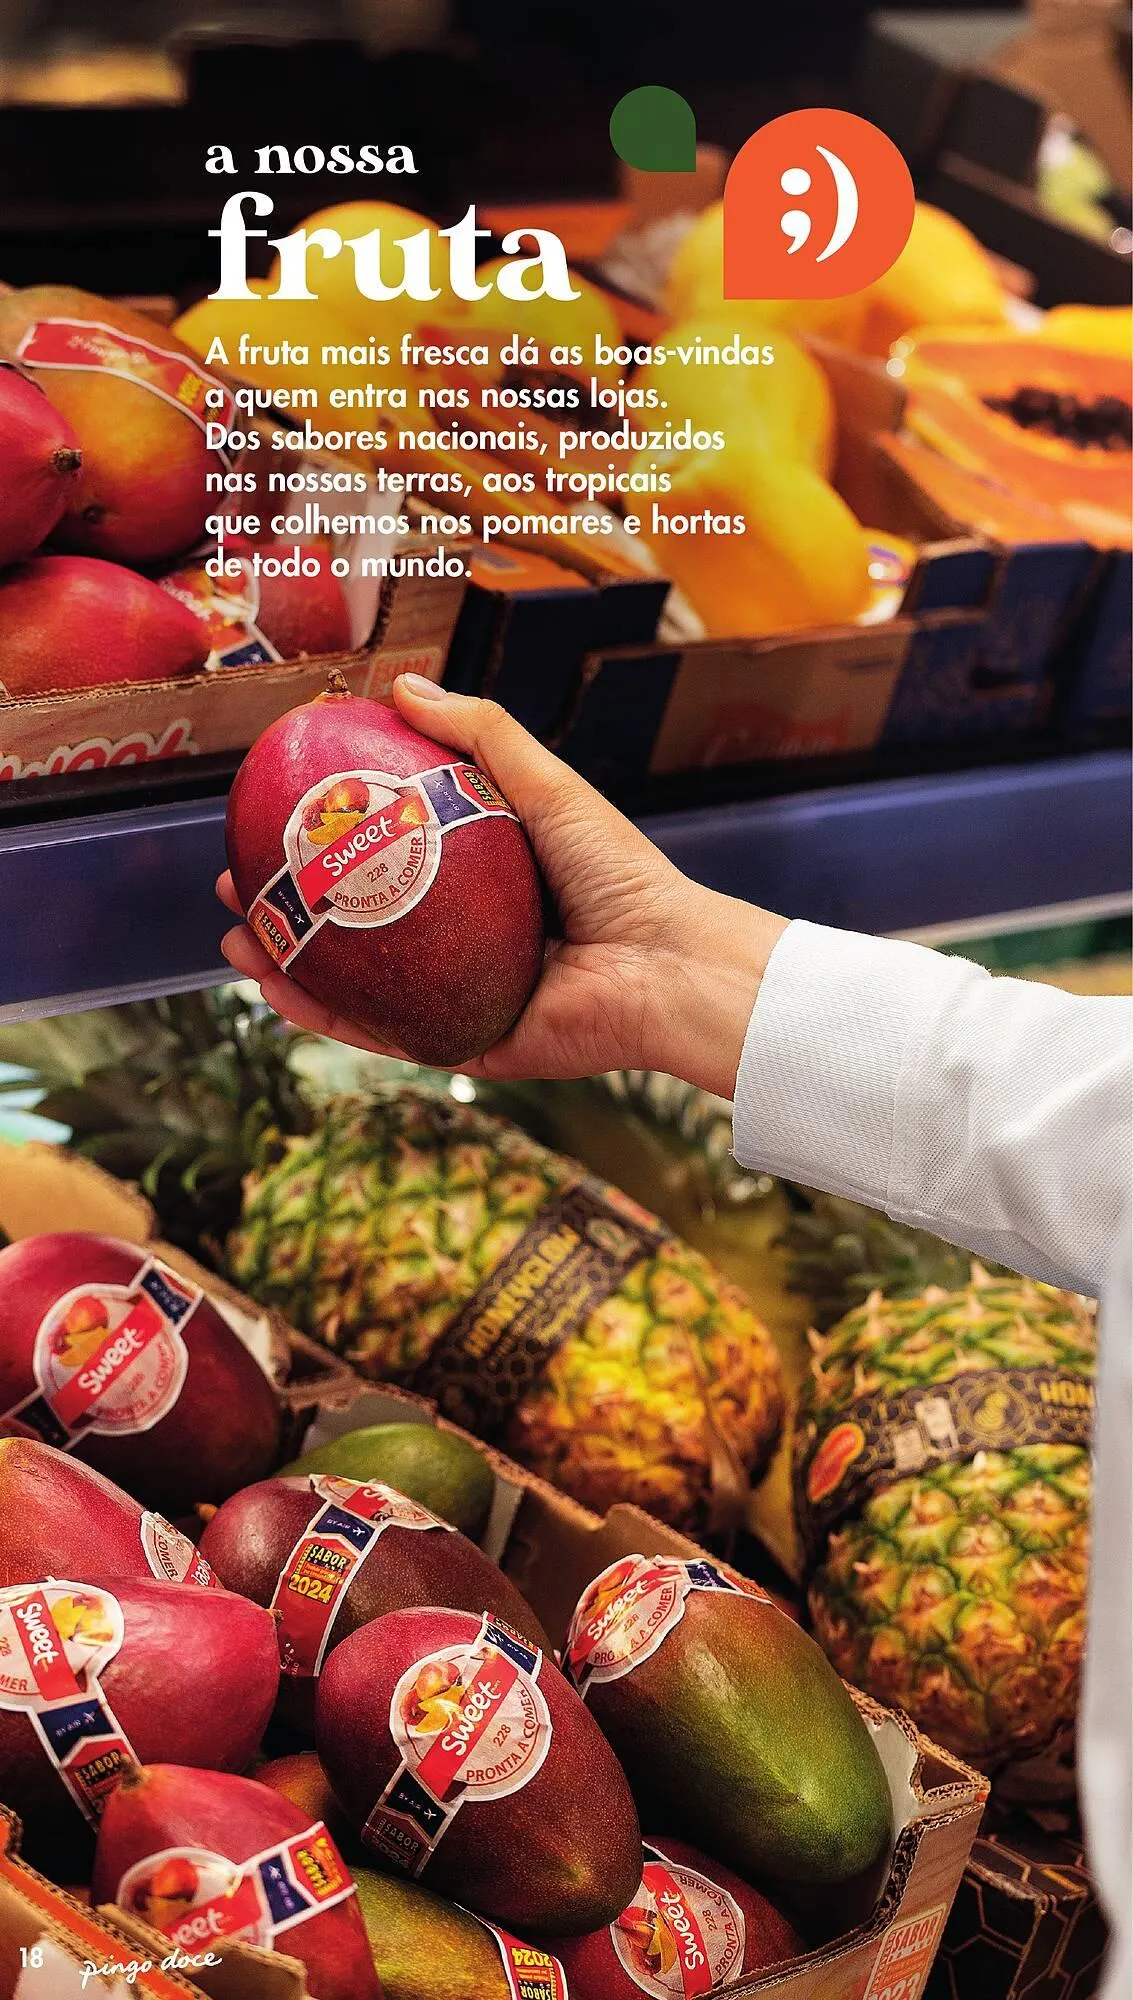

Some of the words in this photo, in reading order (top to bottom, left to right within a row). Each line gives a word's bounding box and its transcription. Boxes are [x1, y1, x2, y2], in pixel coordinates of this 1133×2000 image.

[322, 816, 397, 877] Sweet
[334, 891, 389, 909] PRONTA
[388, 884, 401, 897] A
[397, 836, 424, 886] COMER
[366, 862, 389, 883] 228
[261, 914, 288, 951] SABOR
[77, 1327, 145, 1396] Sweet
[309, 1545, 348, 1570] SABOR
[288, 1573, 334, 1604] 2024
[588, 1579, 649, 1641] Sweet
[639, 1628, 649, 1640] A
[647, 1586, 673, 1627] COMER
[16, 1602, 60, 1667] Sweet
[441, 1681, 502, 1757] Sweet
[492, 1723, 512, 1748] 228
[81, 1751, 121, 1781] SABOR
[466, 1752, 522, 1781] PRONTA
[517, 1741, 530, 1753] A
[384, 1823, 419, 1852] SABOR
[679, 1875, 724, 1907] COMER
[171, 1908, 225, 1945] eet
[660, 1891, 705, 1971] Sweet
[702, 1909, 718, 1932] 228
[720, 1908, 730, 1919] A
[511, 1947, 554, 1968] 2024
[714, 1921, 738, 1976] PRONTA
